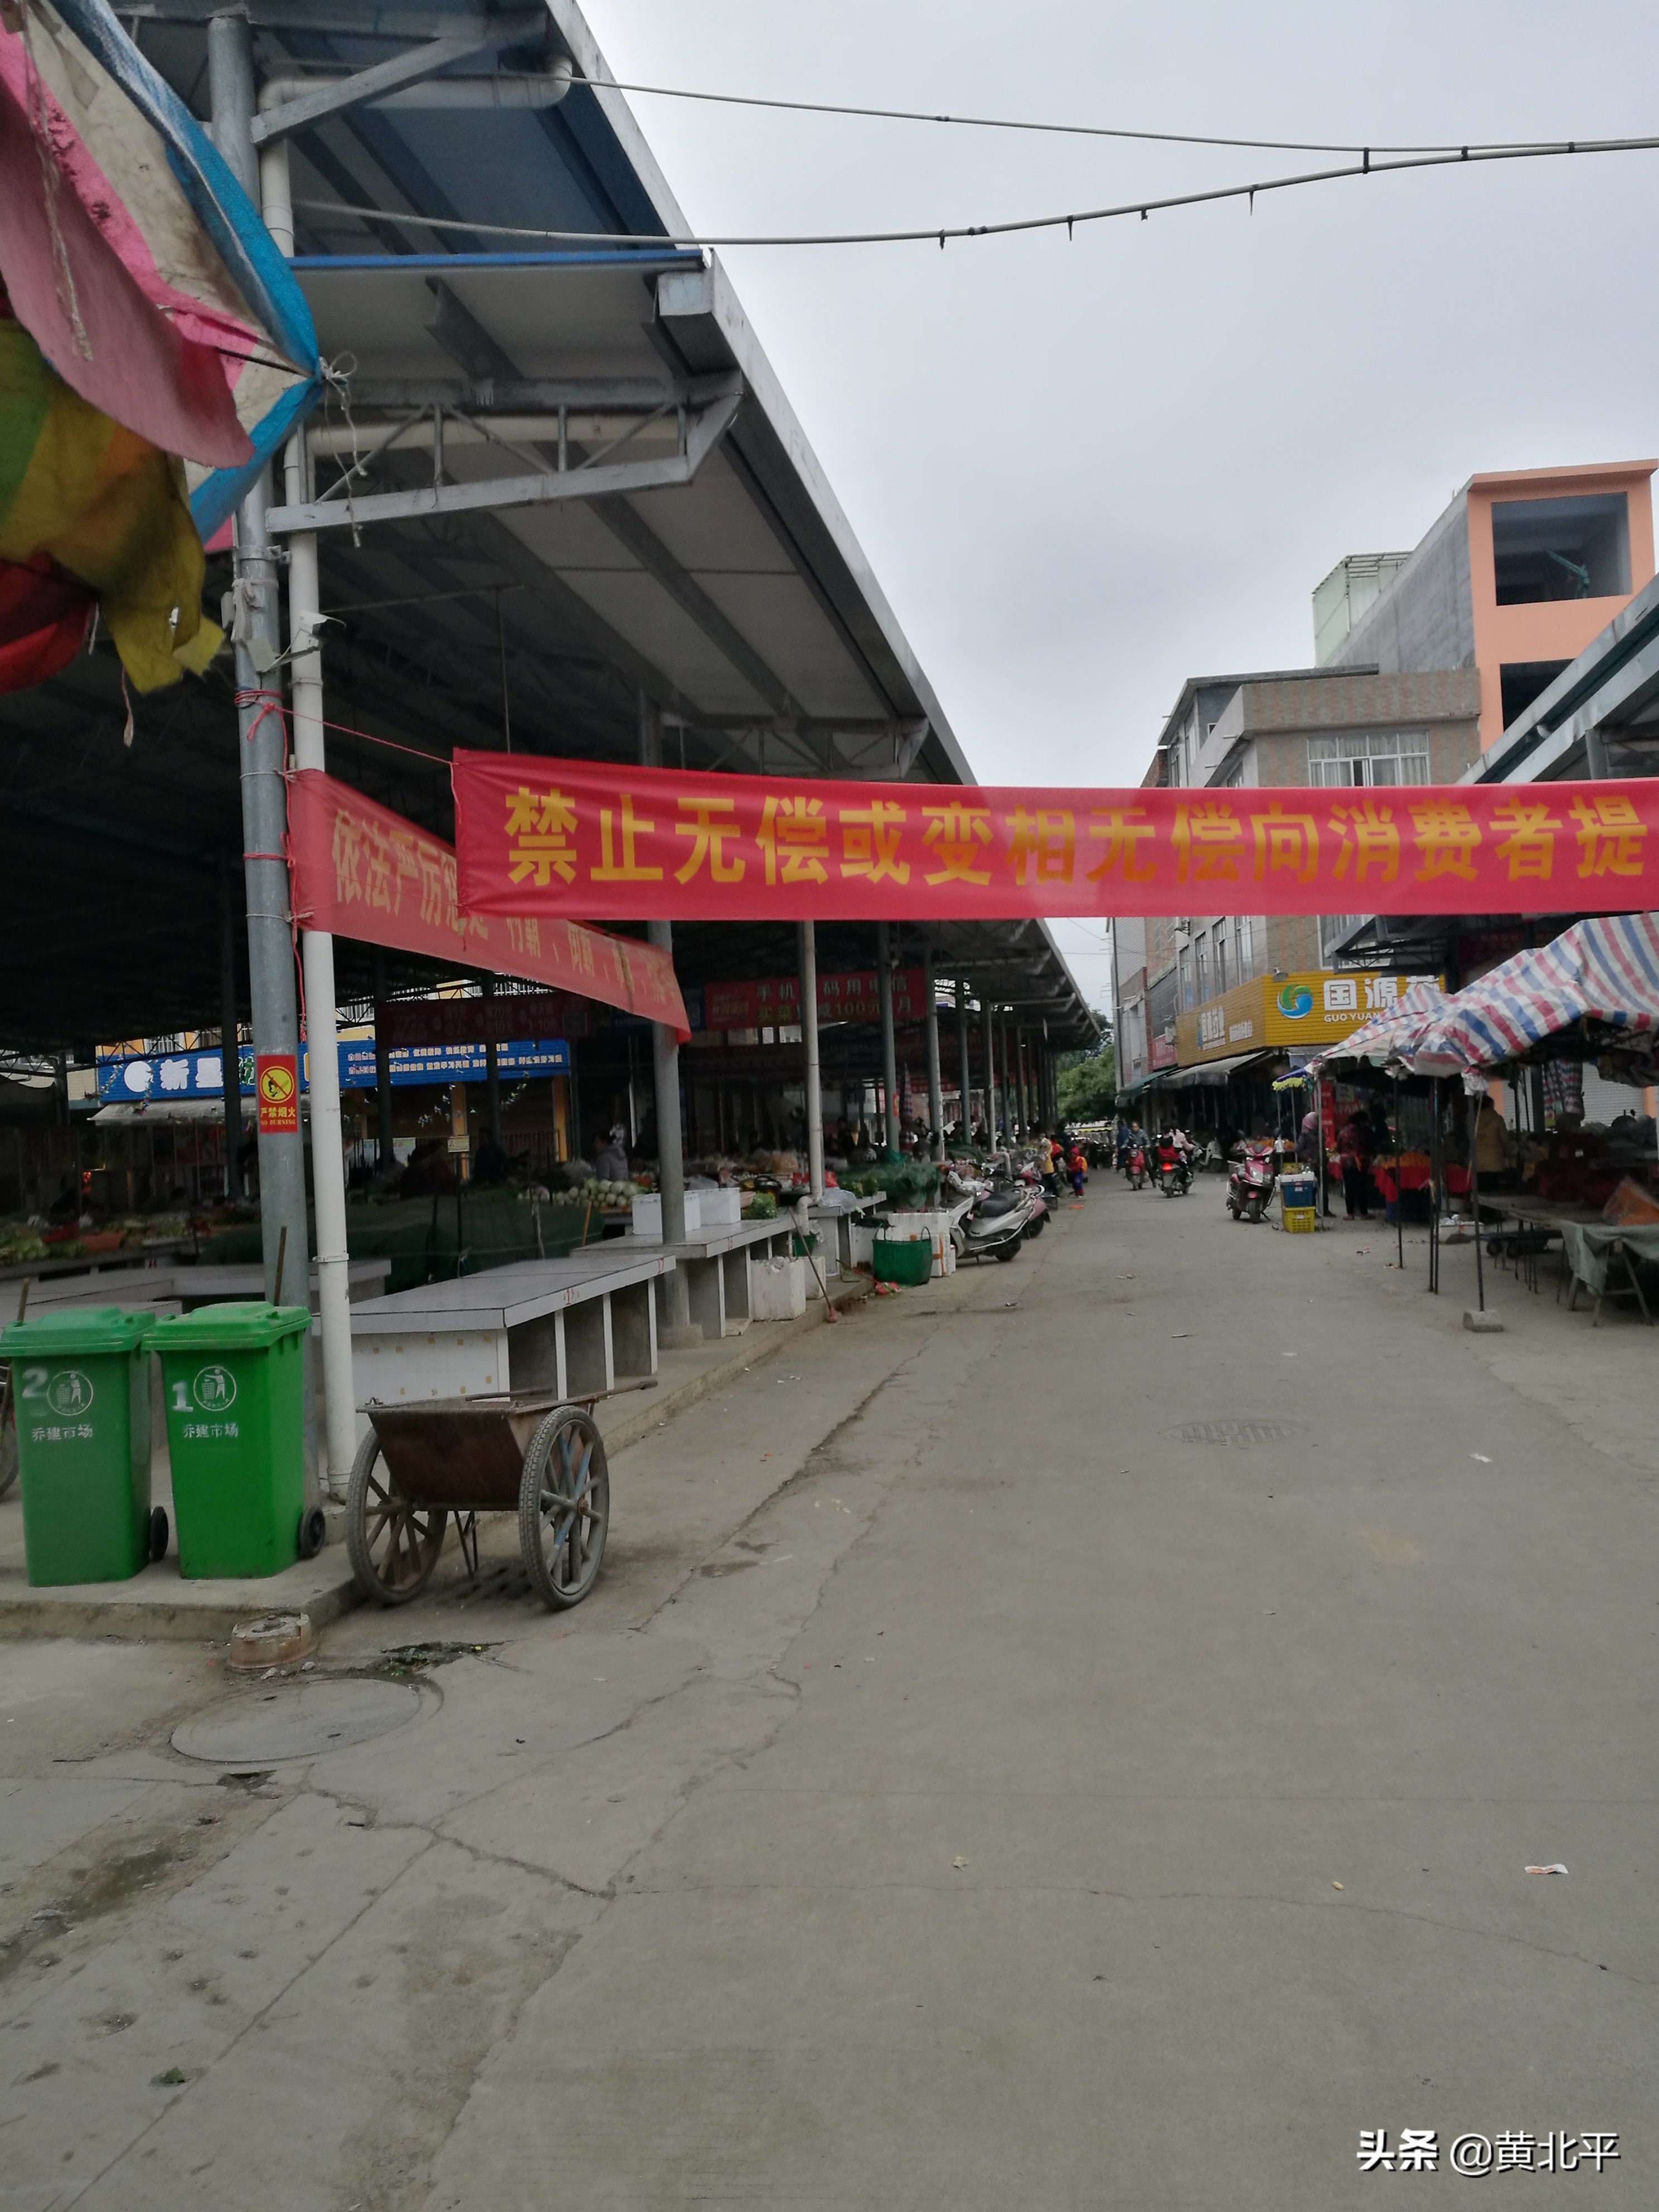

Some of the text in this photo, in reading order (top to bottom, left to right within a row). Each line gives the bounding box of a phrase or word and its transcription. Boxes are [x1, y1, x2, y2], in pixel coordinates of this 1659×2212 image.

[505, 786, 1647, 885] 禁止无偿或变相无偿向消费者提
[1323, 976, 1439, 1011] 国源
[1324, 1013, 1347, 1022] GUO
[260, 1107, 295, 1117] 严禁烟火
[22, 1366, 48, 1398] 2
[172, 1380, 194, 1413] 1
[183, 1423, 239, 1438] 乔建市场
